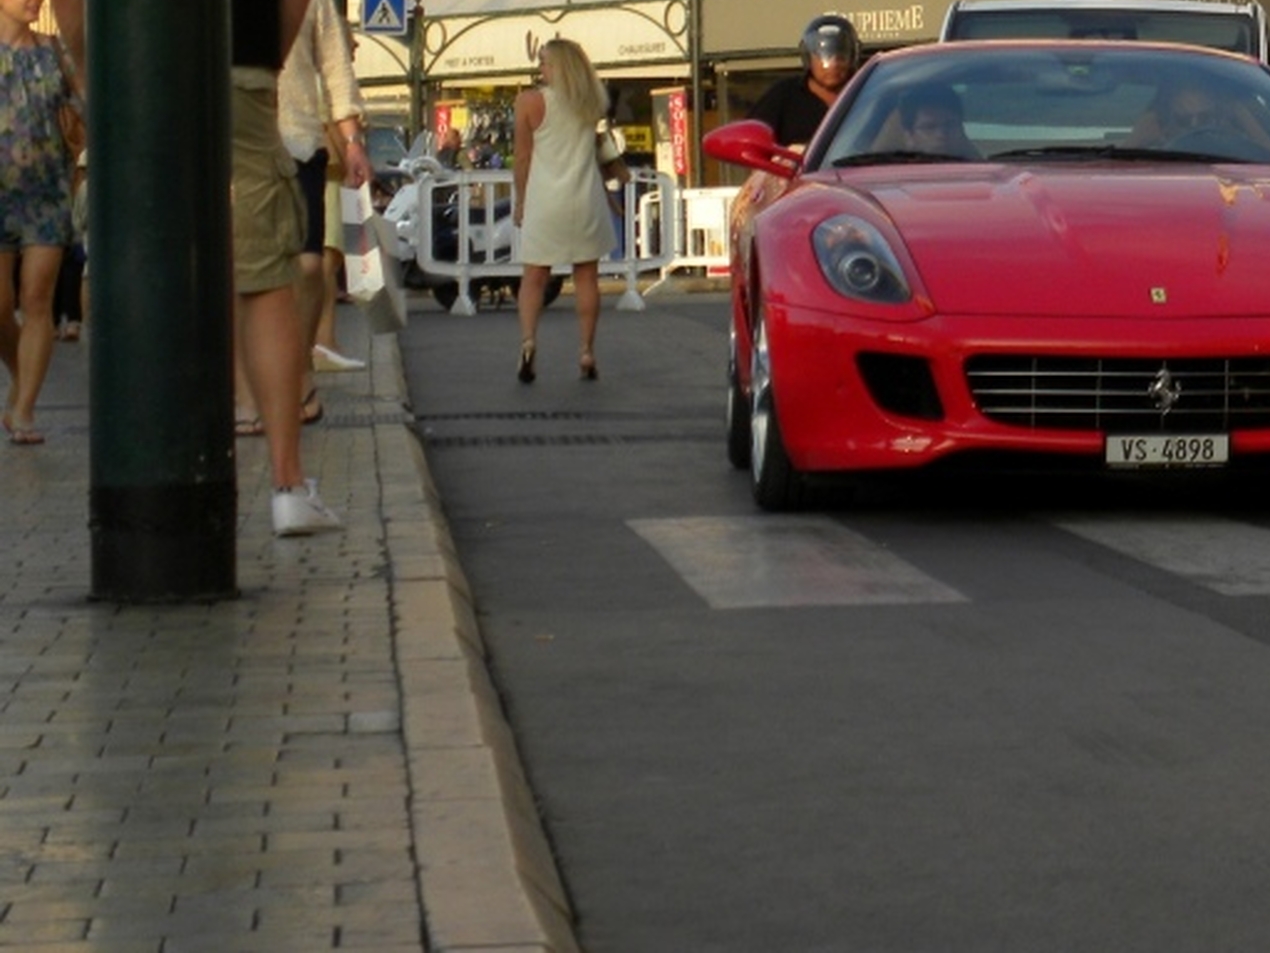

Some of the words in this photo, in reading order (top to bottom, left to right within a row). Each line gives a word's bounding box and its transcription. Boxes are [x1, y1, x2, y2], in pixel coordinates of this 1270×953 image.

[670, 92, 685, 174] SOLDES
[1121, 438, 1147, 461] VS
[1162, 438, 1214, 462] 4898
